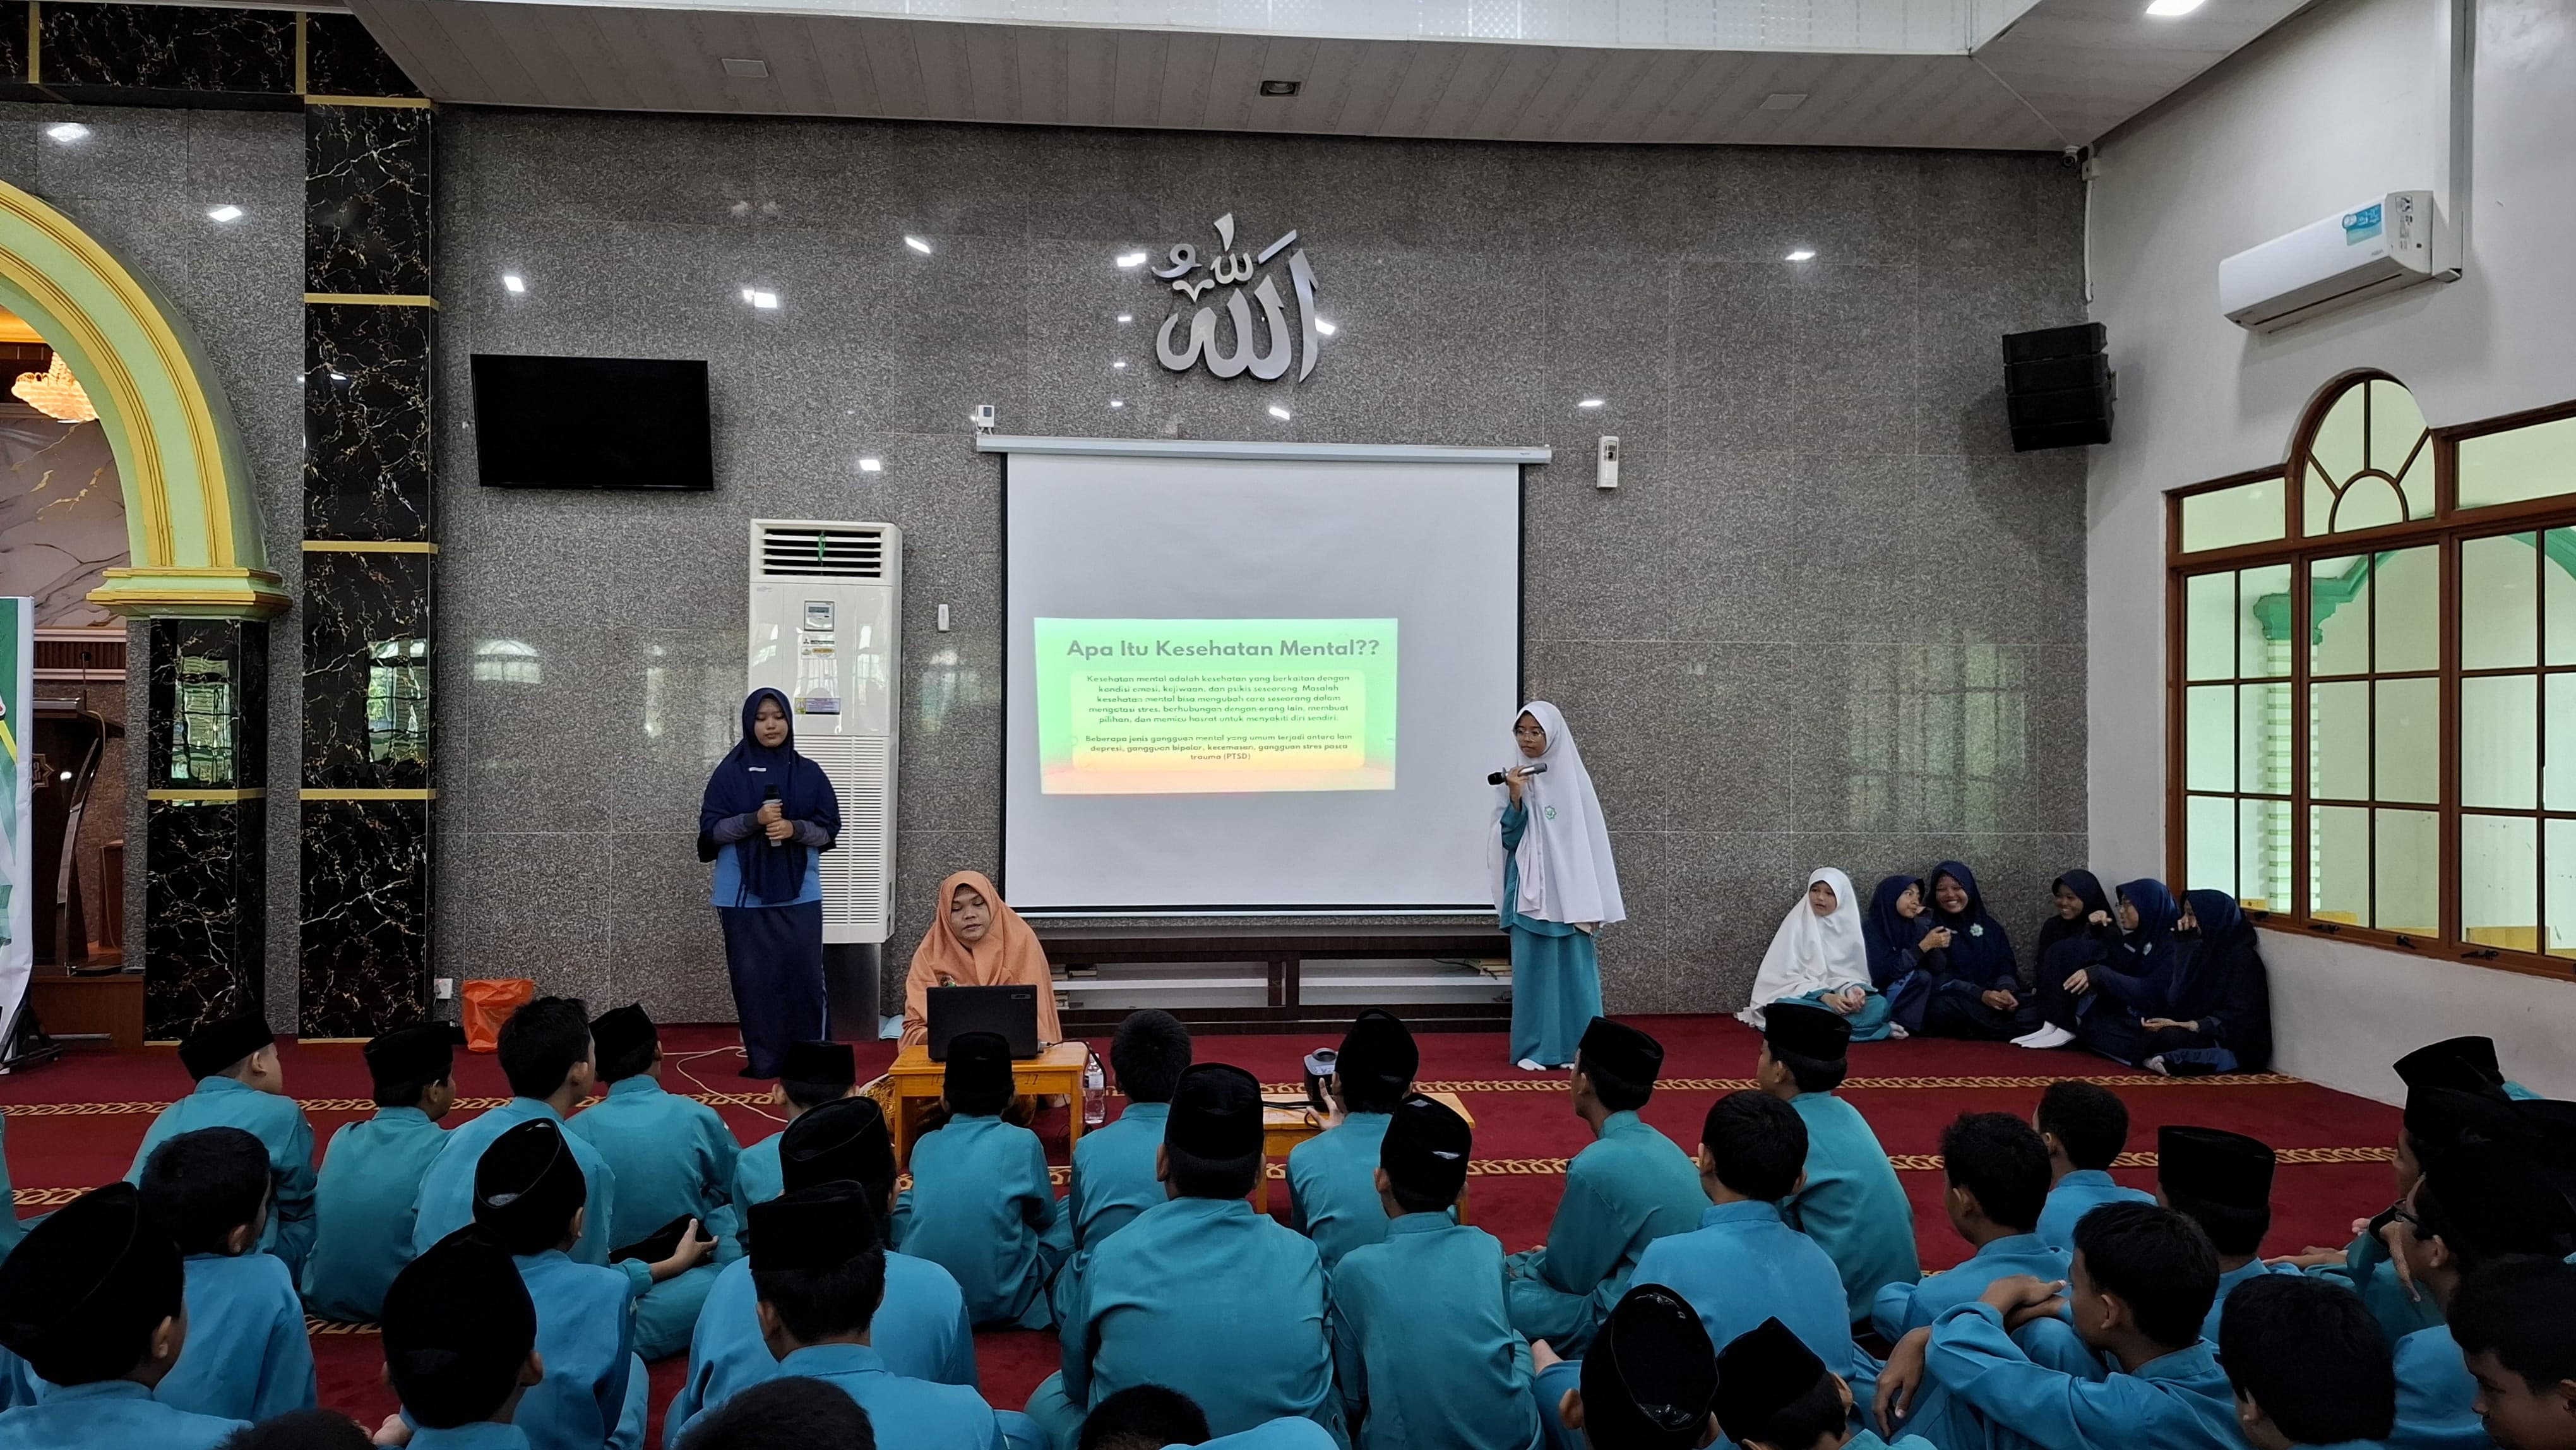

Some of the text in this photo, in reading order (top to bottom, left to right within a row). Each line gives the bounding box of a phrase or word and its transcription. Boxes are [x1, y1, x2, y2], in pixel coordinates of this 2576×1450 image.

[1067, 639, 1380, 661] Apa Itu Kesehatan Mental??
[1317, 674, 1349, 683] dengan
[1198, 695, 1243, 704] mengubah
[1163, 705, 1222, 714] berhubungan
[1225, 705, 1256, 714] dengan
[1246, 715, 1288, 723] menyakiti
[1086, 735, 1127, 743] Beberapa
[1129, 735, 1148, 743] jenis
[1278, 734, 1304, 742] terjadi
